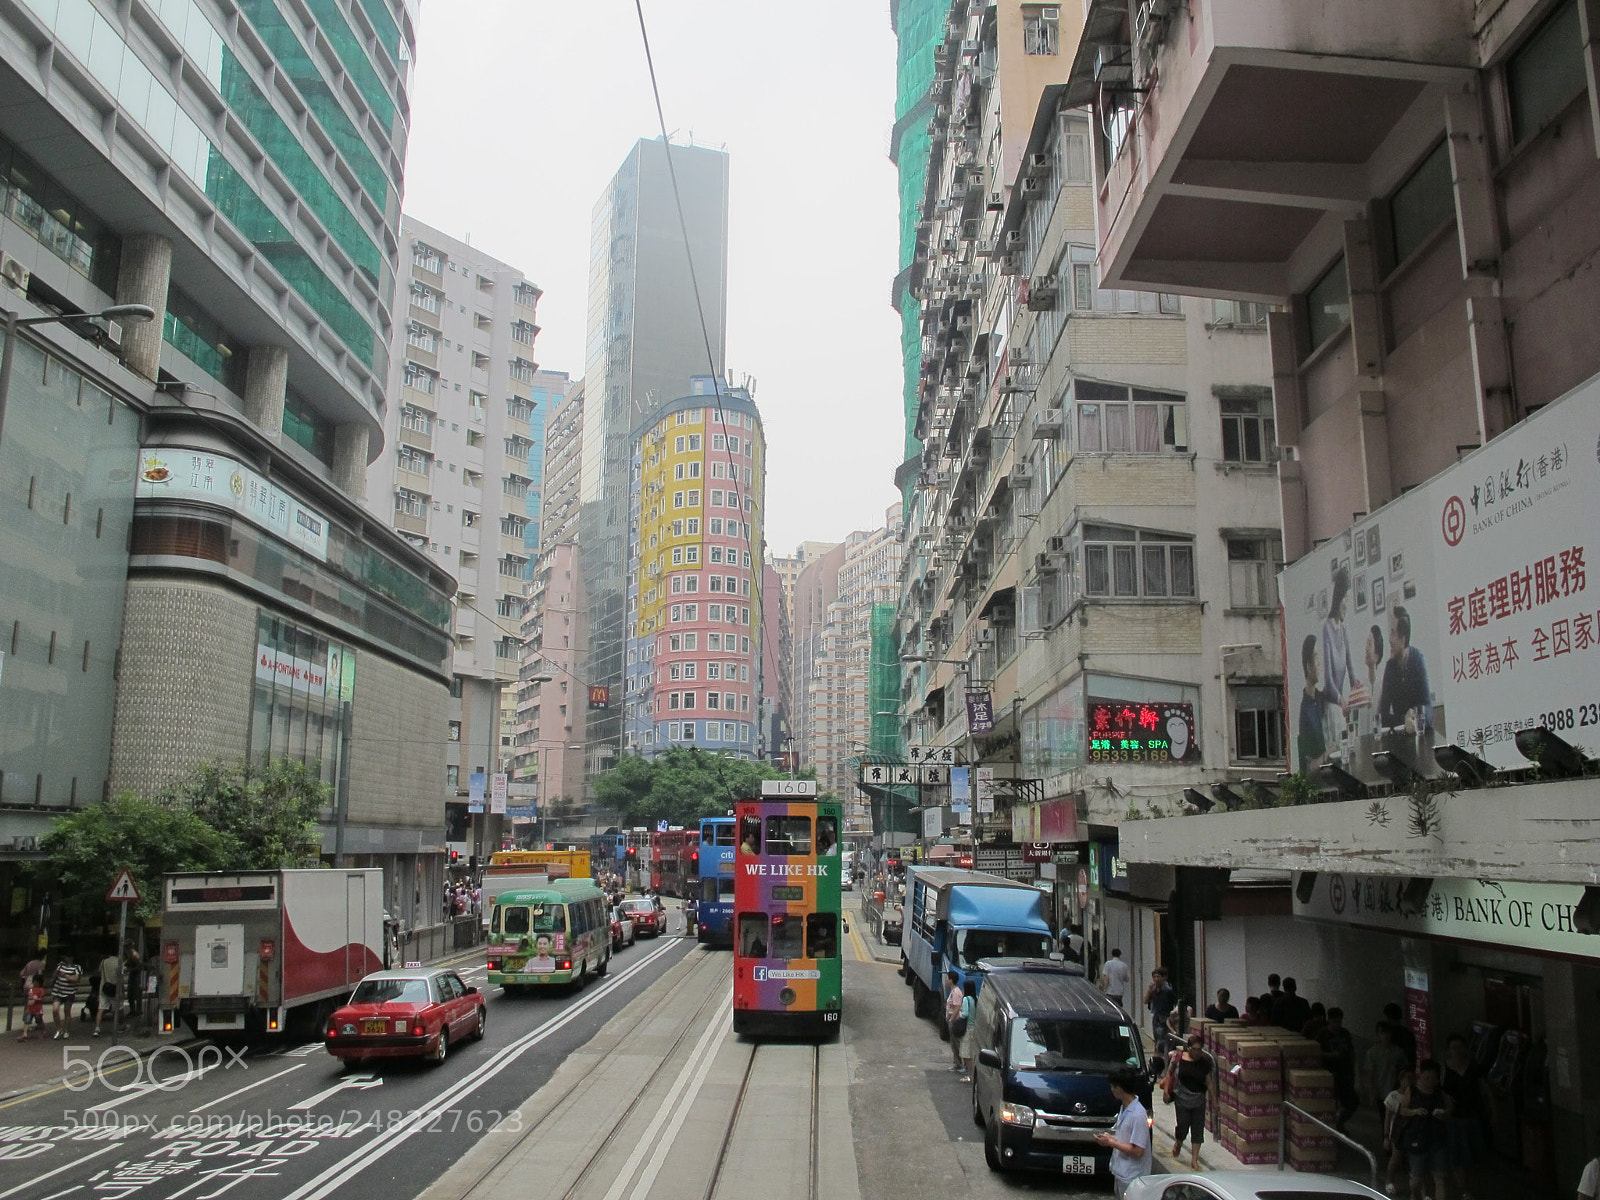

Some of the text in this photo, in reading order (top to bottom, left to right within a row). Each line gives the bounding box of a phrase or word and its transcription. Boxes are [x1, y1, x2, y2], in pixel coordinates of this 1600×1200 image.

[190, 472, 213, 490] 江南
[1472, 513, 1494, 535] BANK
[1494, 508, 1505, 524] OF
[1505, 496, 1534, 518] CHINA
[1447, 545, 1586, 636] 家庭理財服務
[1452, 610, 1600, 684] 以家為本 全因家
[973, 702, 988, 722] 沐足
[1539, 702, 1600, 732] 3988 23
[1092, 750, 1169, 761] 9533 5169
[777, 781, 808, 794] 160
[824, 807, 836, 816] 160
[720, 849, 734, 859] citi
[745, 863, 828, 876] WE LIKE HK
[1453, 896, 1579, 933] BANK OF CH
[823, 1012, 838, 1021] 160
[0, 1125, 150, 1142] NSTON
[150, 1122, 374, 1140] WAN CHAI
[144, 1140, 320, 1158] ROAD
[1065, 1164, 1092, 1174] 9926
[1072, 1156, 1086, 1166] SL
